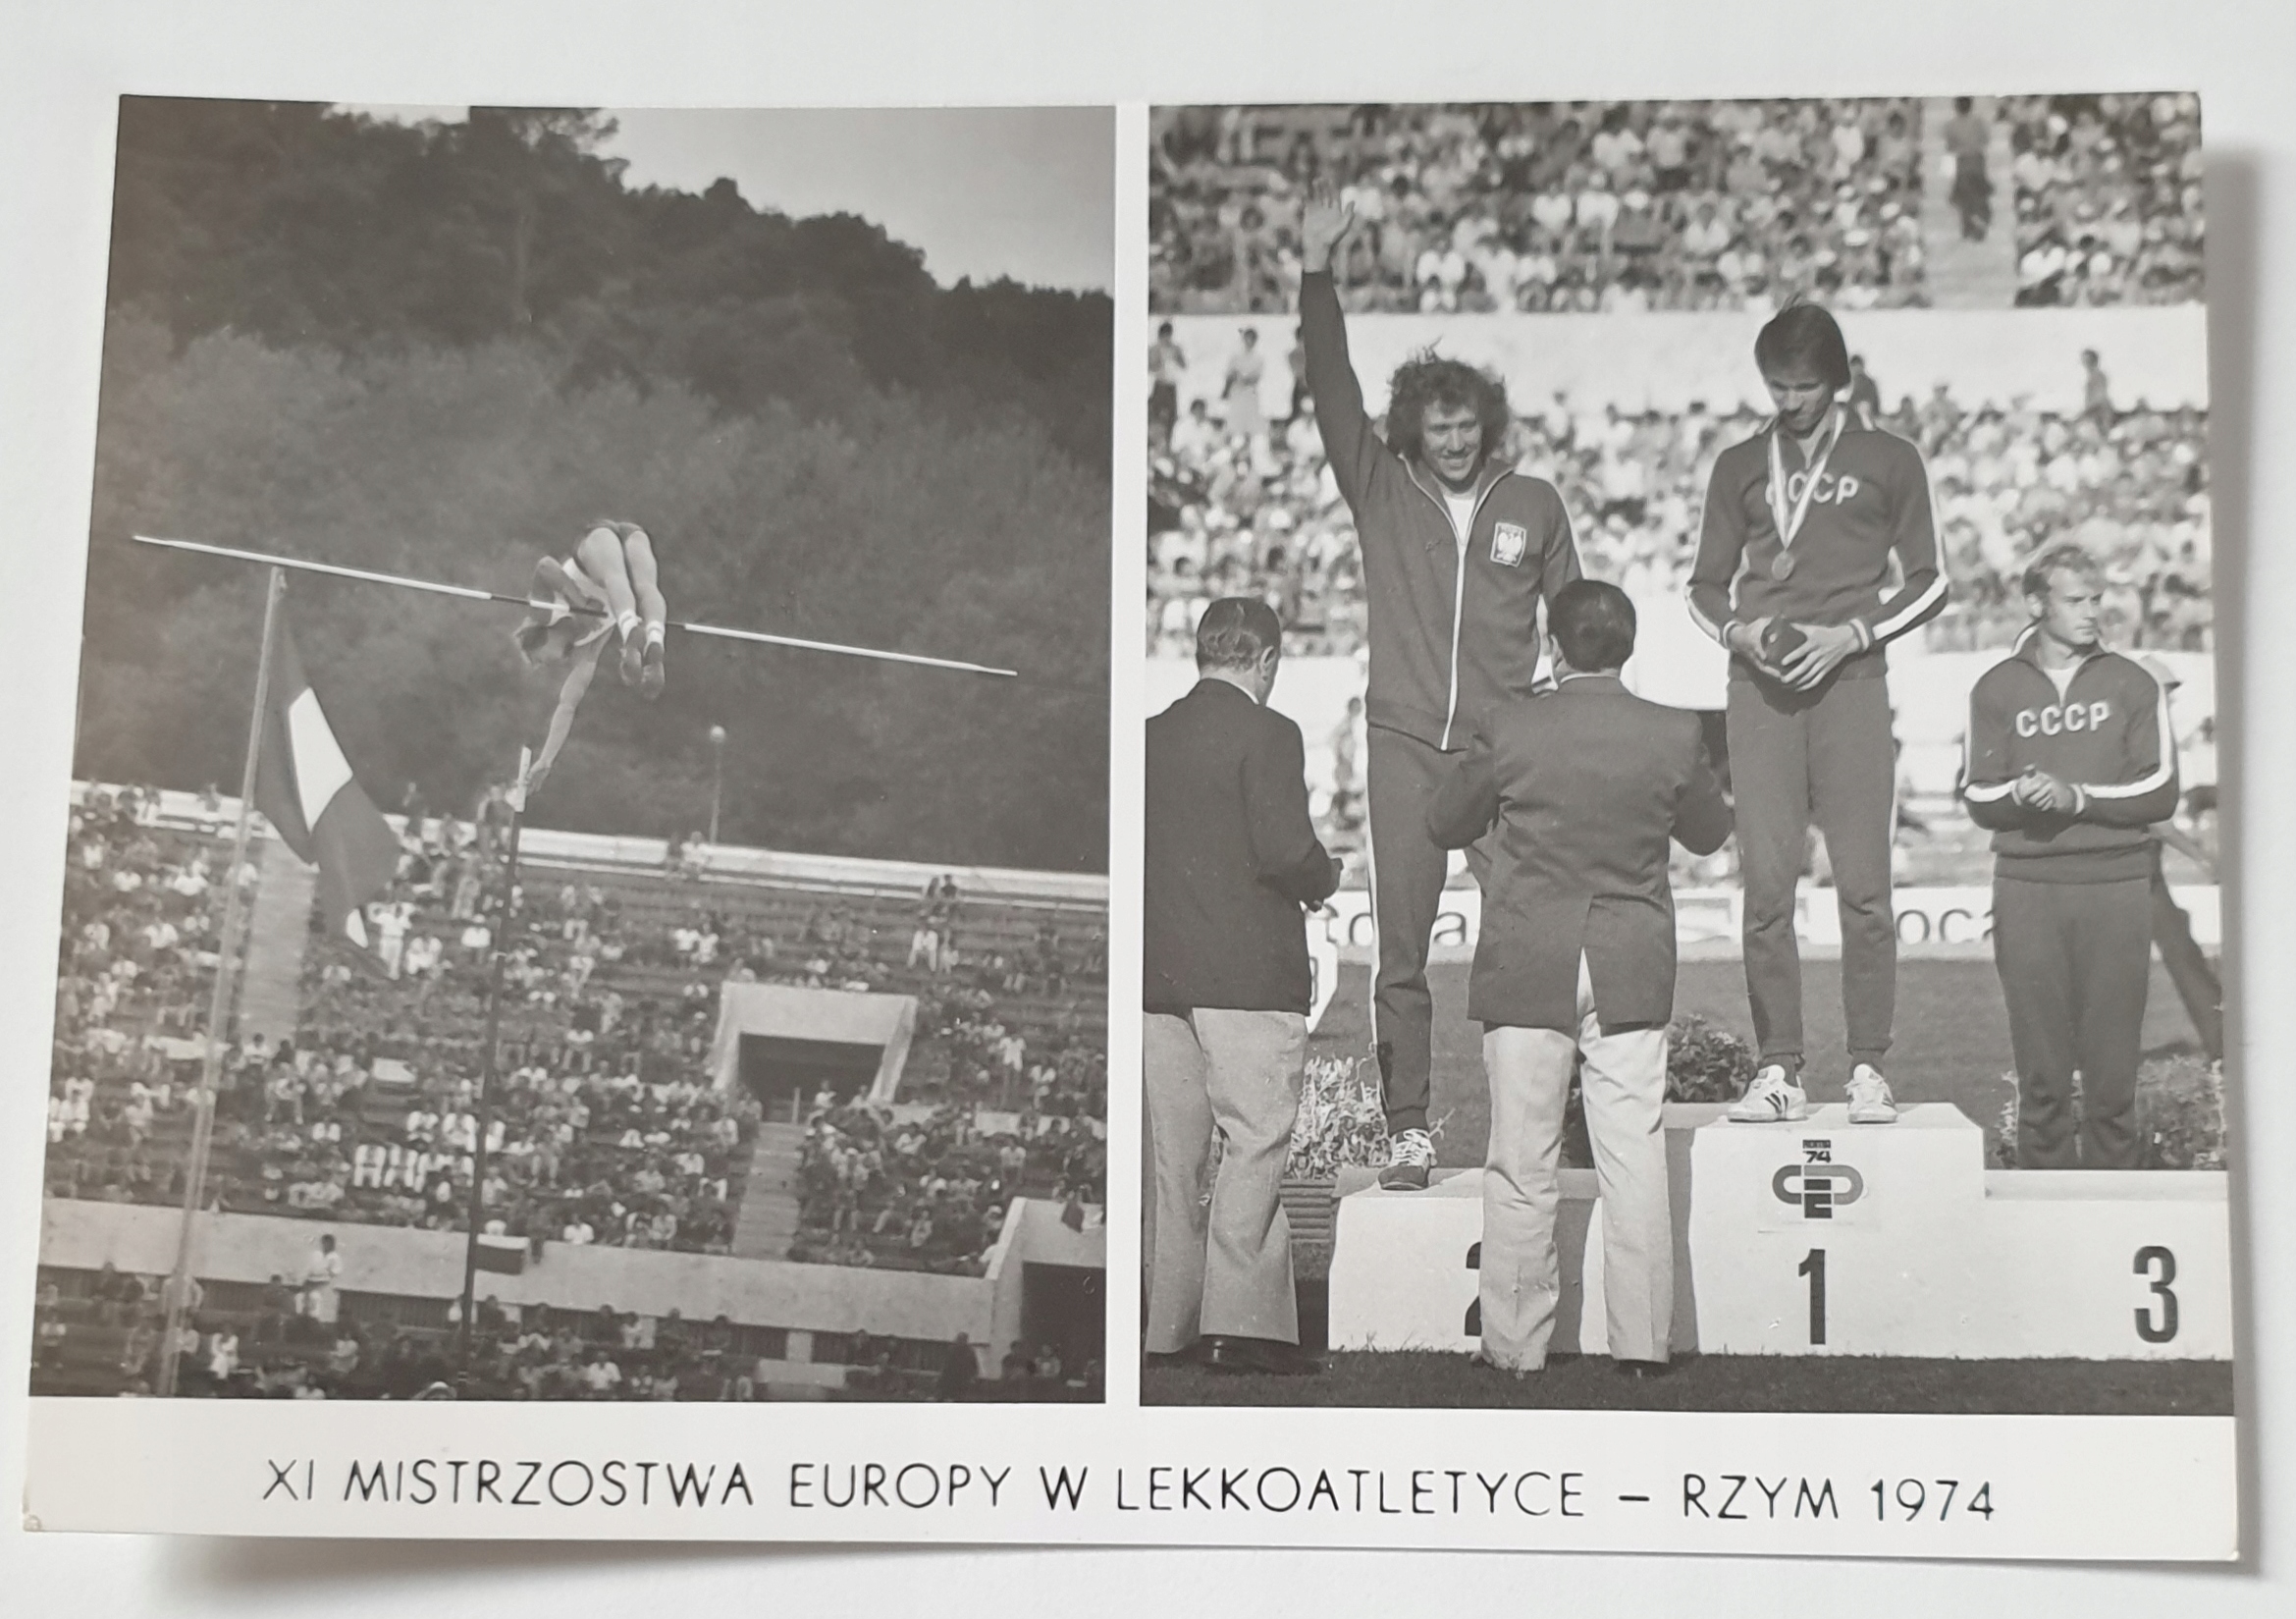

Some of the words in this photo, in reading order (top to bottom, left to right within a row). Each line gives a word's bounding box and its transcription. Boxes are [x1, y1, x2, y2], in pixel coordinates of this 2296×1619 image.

[2015, 702, 2110, 738] СССР
[1802, 1151, 1832, 1163] 74
[1798, 1249, 1827, 1345] 1
[2132, 1245, 2179, 1344] 3
[263, 1459, 314, 1501] XI
[344, 1458, 754, 1508] MISTRZOSTWA
[790, 1463, 1012, 1509] EUROPY
[1040, 1466, 1089, 1512] W
[1117, 1467, 1584, 1518] LEKKOATLETYCE
[1683, 1474, 1839, 1520] RZYM
[1871, 1479, 1995, 1522] 1974
